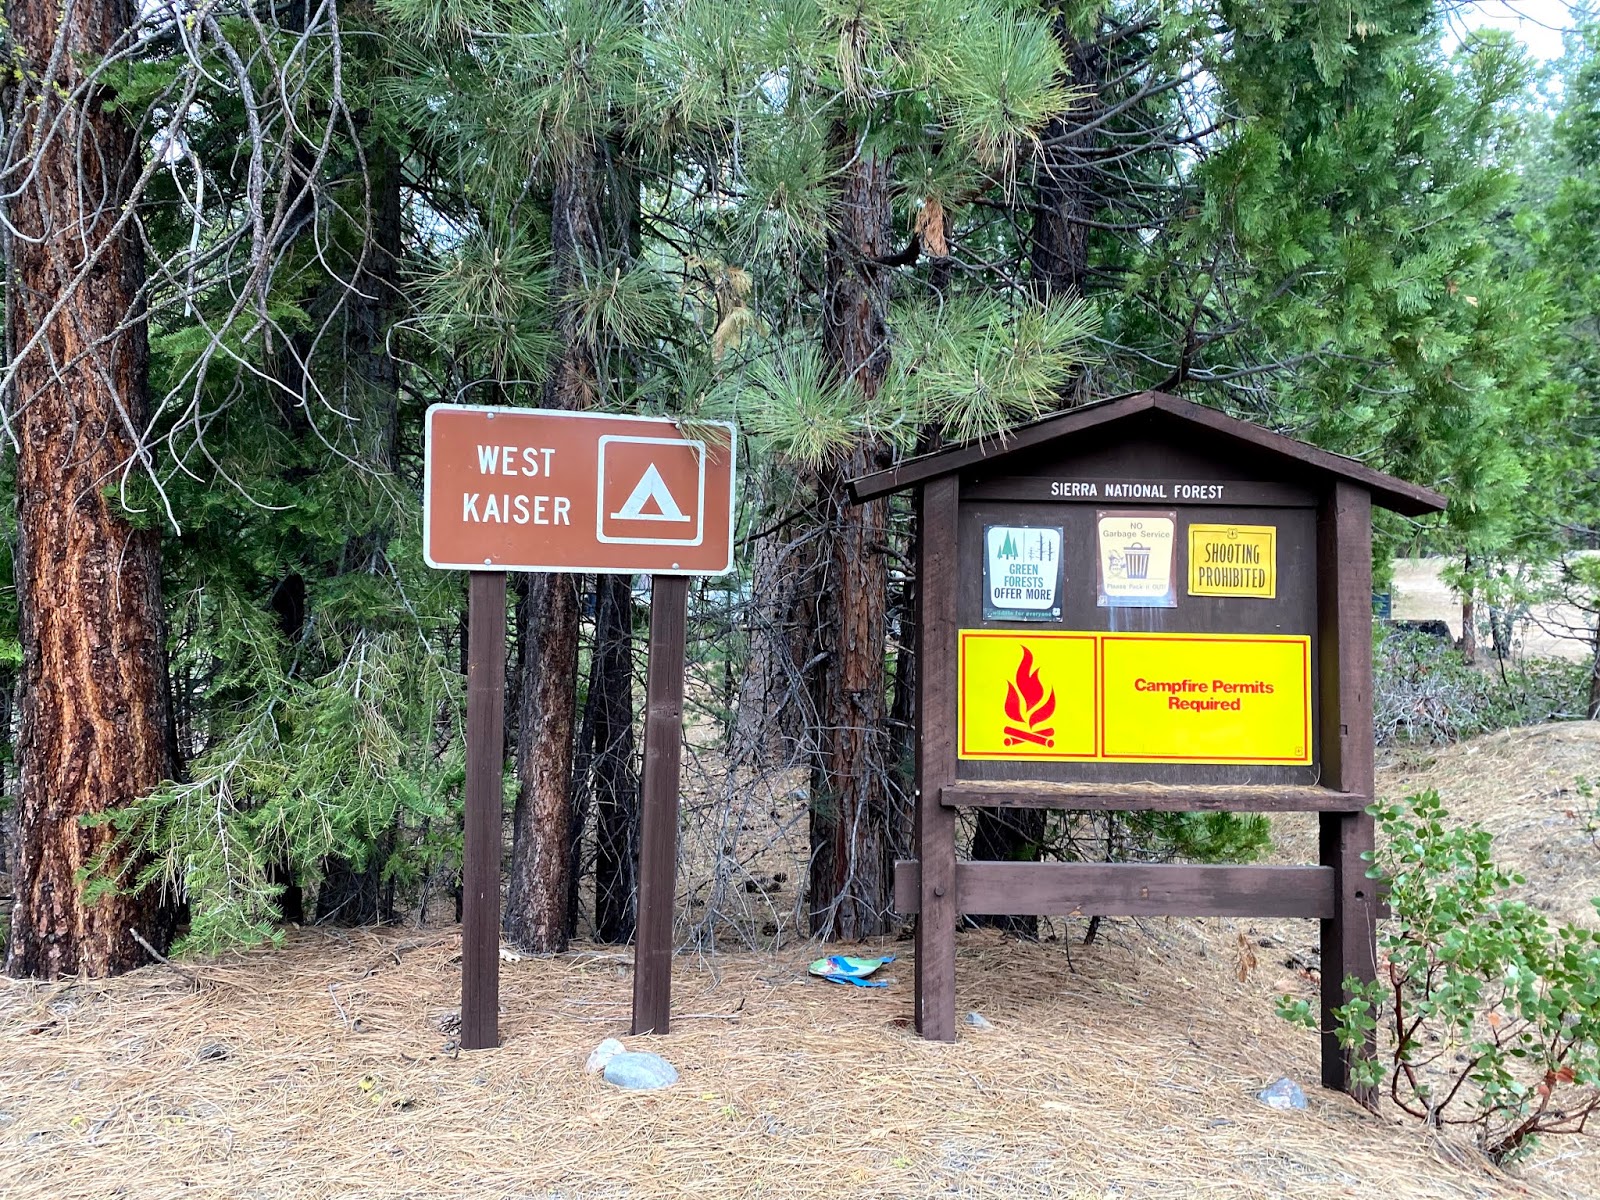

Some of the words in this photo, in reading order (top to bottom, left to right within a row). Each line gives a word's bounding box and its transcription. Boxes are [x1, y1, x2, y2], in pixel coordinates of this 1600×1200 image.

[477, 445, 555, 478] WEST
[1051, 482, 1098, 496] SIERRA
[1105, 483, 1167, 498] NATIONAL
[1174, 485, 1224, 499] FOREST
[463, 493, 571, 525] KAISER
[1103, 530, 1137, 539] Garbage
[1140, 530, 1170, 538] Service
[1130, 522, 1143, 530] NO
[1205, 543, 1260, 564] SHOOTING
[1009, 563, 1039, 575] GREEN
[1199, 566, 1266, 588] PROHIBITED
[1004, 575, 1044, 588] FORESTS
[994, 587, 1022, 599] OFFER
[1025, 588, 1052, 600] MORE
[1134, 678, 1209, 695] Campfire
[1212, 680, 1275, 694] Permits
[1168, 696, 1241, 713] Required
